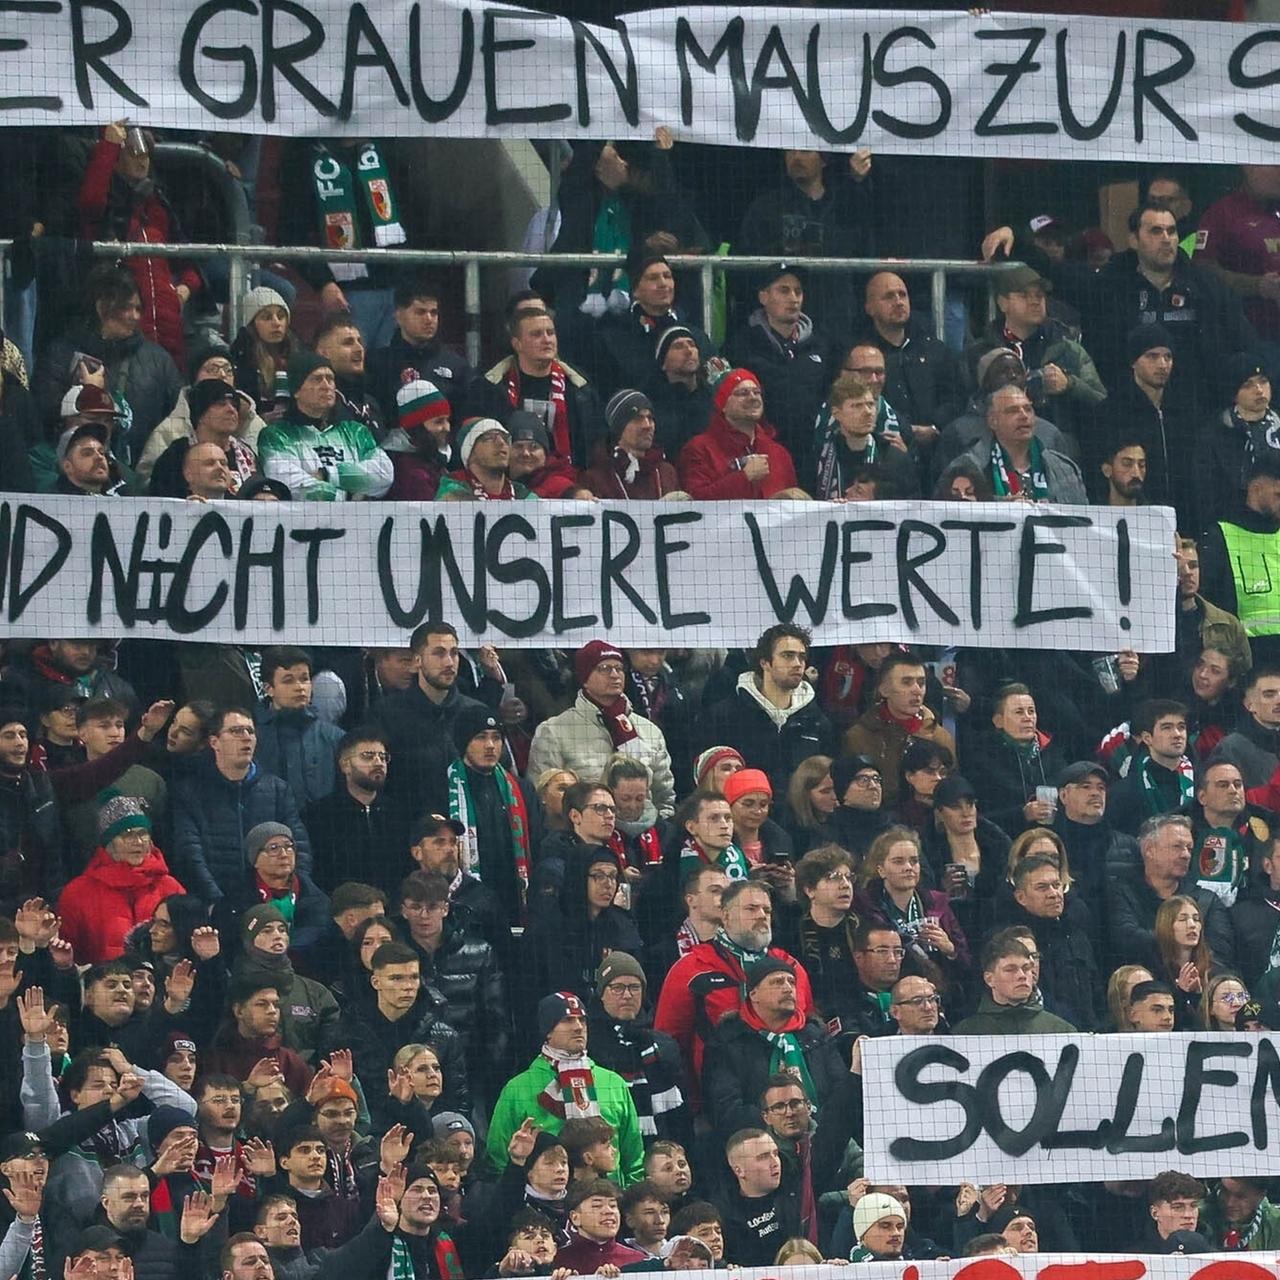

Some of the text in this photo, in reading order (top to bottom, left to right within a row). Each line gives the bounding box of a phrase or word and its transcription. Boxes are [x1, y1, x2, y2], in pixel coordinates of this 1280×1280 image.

[179, 3, 640, 128] GRAUEN
[675, 17, 951, 144] MAUS
[975, 27, 1198, 143] ZUR
[88, 512, 347, 630] NICHT
[379, 512, 711, 638] UNSERE
